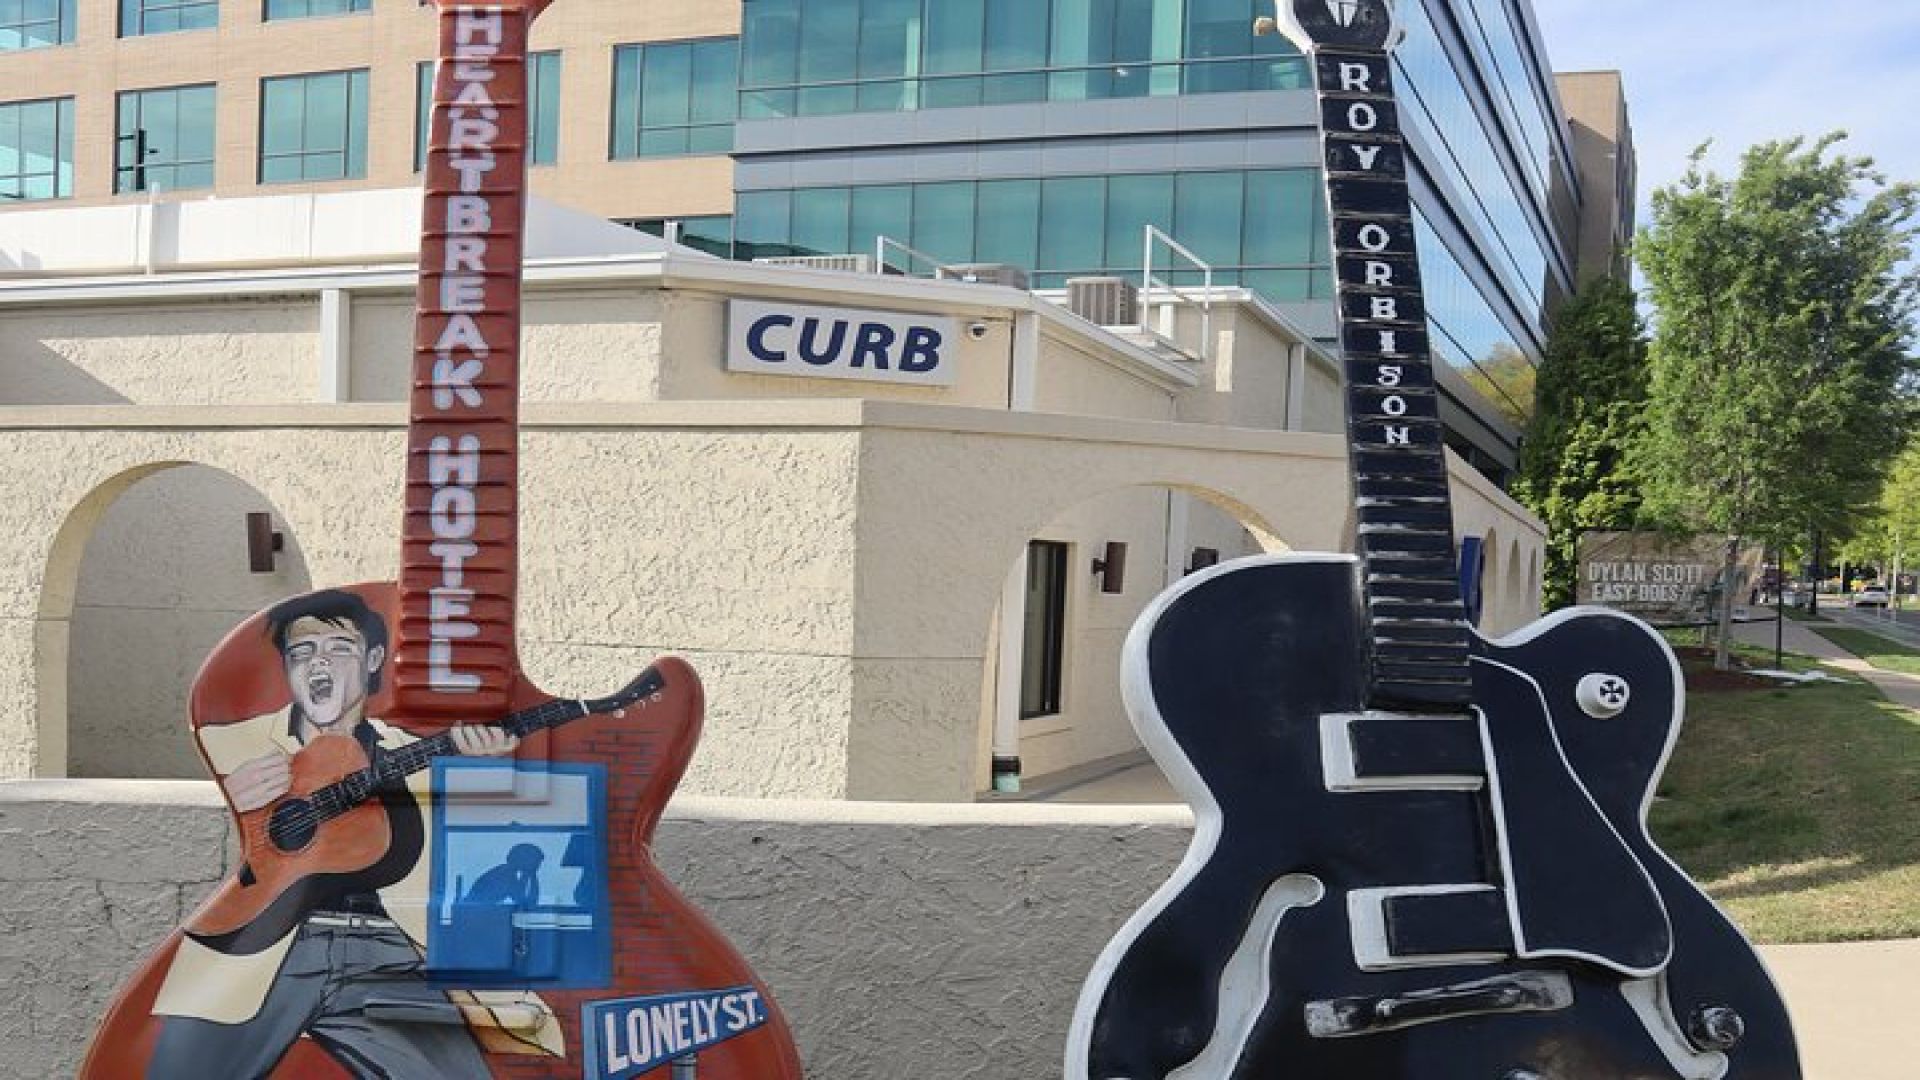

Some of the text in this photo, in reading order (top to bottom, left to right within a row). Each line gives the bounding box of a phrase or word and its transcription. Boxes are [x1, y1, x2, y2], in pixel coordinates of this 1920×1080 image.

[1339, 62, 1409, 444] ROY ORBISON
[428, 5, 502, 691] HEARTBREAK HOTEL
[746, 314, 942, 372] CURB
[1588, 562, 1704, 584] DYLAN SCOTT
[1592, 583, 1634, 601] EASY
[1640, 584, 1678, 602] DOES
[604, 991, 764, 1074] LONELY ST.
